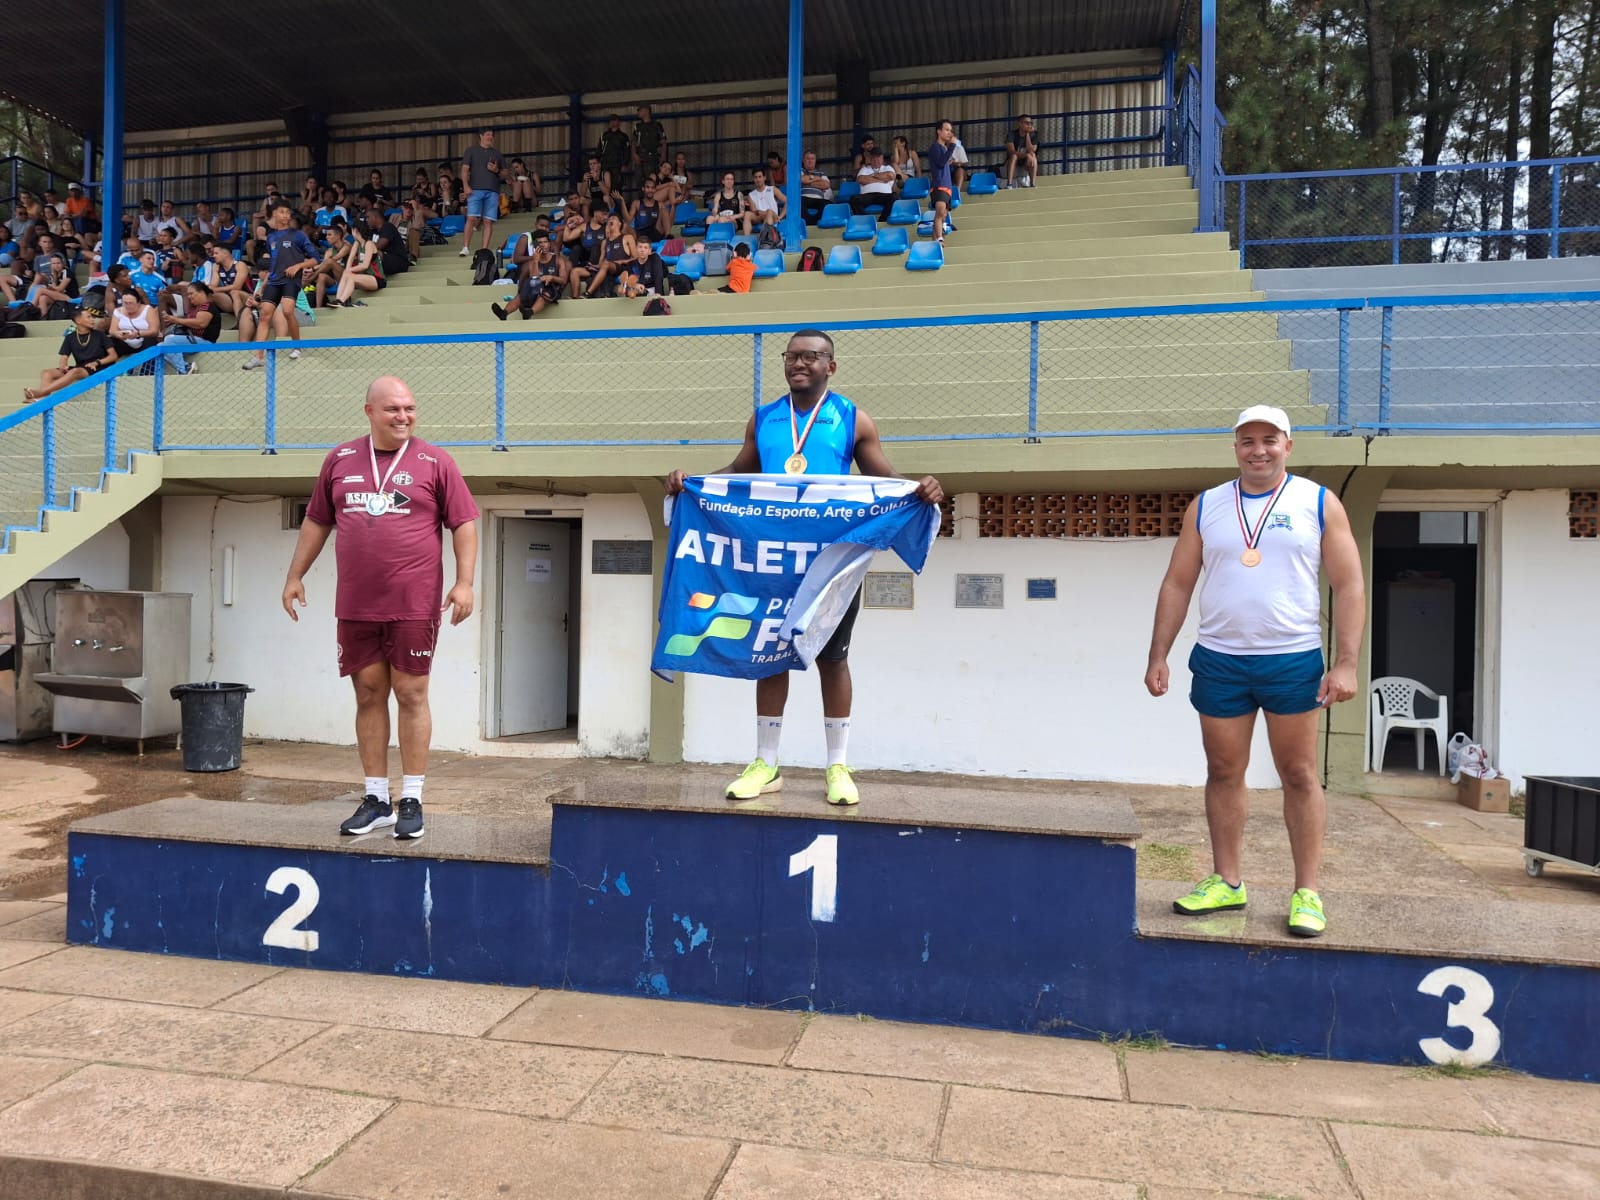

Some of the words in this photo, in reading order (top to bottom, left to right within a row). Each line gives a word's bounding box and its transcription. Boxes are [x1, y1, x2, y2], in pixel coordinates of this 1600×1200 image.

[699, 498, 762, 516] Fundação
[765, 505, 821, 520] Esporte,
[823, 504, 853, 518] Arte
[857, 508, 866, 518] e
[675, 529, 833, 575] ATLET
[751, 649, 797, 664] TRABAL
[263, 866, 320, 952] 2
[788, 834, 838, 923] 1
[1417, 965, 1501, 1069] 3
